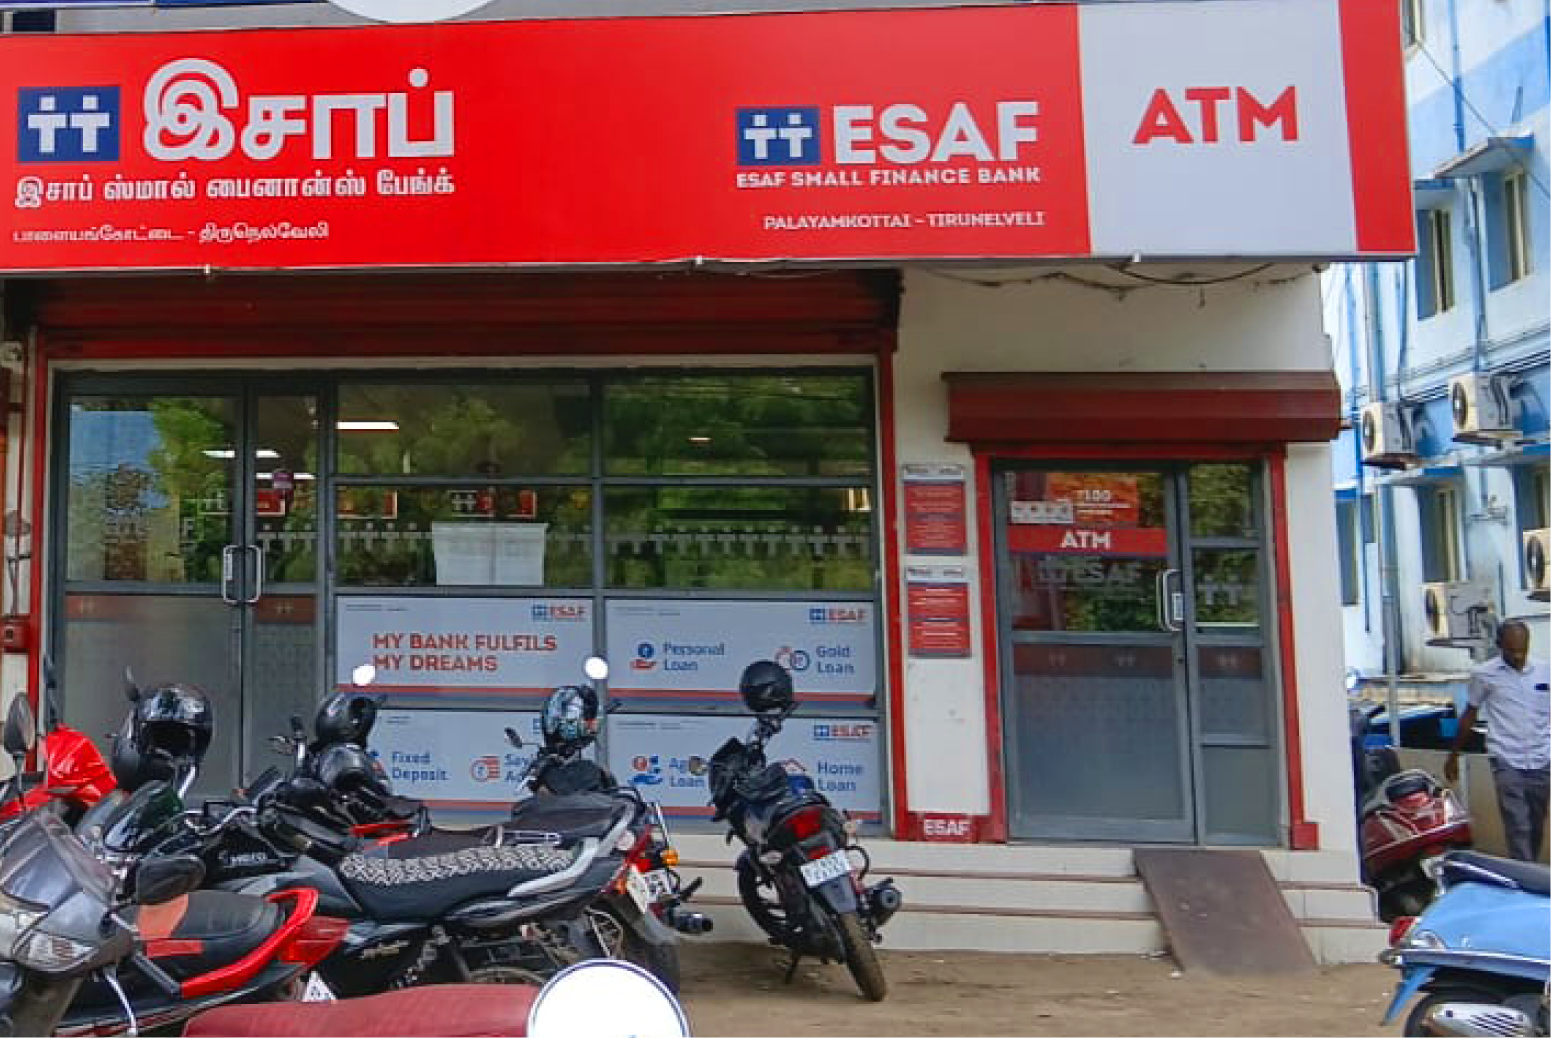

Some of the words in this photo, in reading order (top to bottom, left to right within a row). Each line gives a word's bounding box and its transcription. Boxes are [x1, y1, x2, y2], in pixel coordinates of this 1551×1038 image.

[143, 57, 456, 162] இசாப்
[1132, 85, 1300, 145] ATM
[833, 101, 1040, 165] ESAF
[14, 173, 93, 208] இசாப்
[103, 170, 196, 201] ஸ்மால்
[206, 168, 366, 200] பைனான்ஸ்
[376, 166, 456, 197] பேங்க்
[736, 171, 786, 189] ESAF
[791, 170, 863, 187] SMALL
[869, 168, 971, 186] FINANCE
[977, 167, 1041, 185] BANK
[763, 213, 912, 230] PALAYAMKOTTAI
[927, 211, 1046, 228] TIRUNELVELI
[1060, 530, 1111, 549] ATM
[372, 632, 404, 649] MY
[409, 632, 469, 650] BANK
[475, 634, 558, 652] FULFILS
[662, 642, 725, 657] Personal
[815, 645, 850, 659] Gold
[373, 654, 404, 671] MY
[409, 654, 498, 672] DREAMS
[663, 659, 699, 672] Loan
[816, 661, 855, 674] Loan
[391, 750, 431, 764] Fixed
[391, 766, 448, 784] Deposit
[817, 761, 863, 776] Home
[670, 775, 705, 789] Loan
[818, 778, 856, 792] Loan
[923, 818, 972, 837] ESAF
